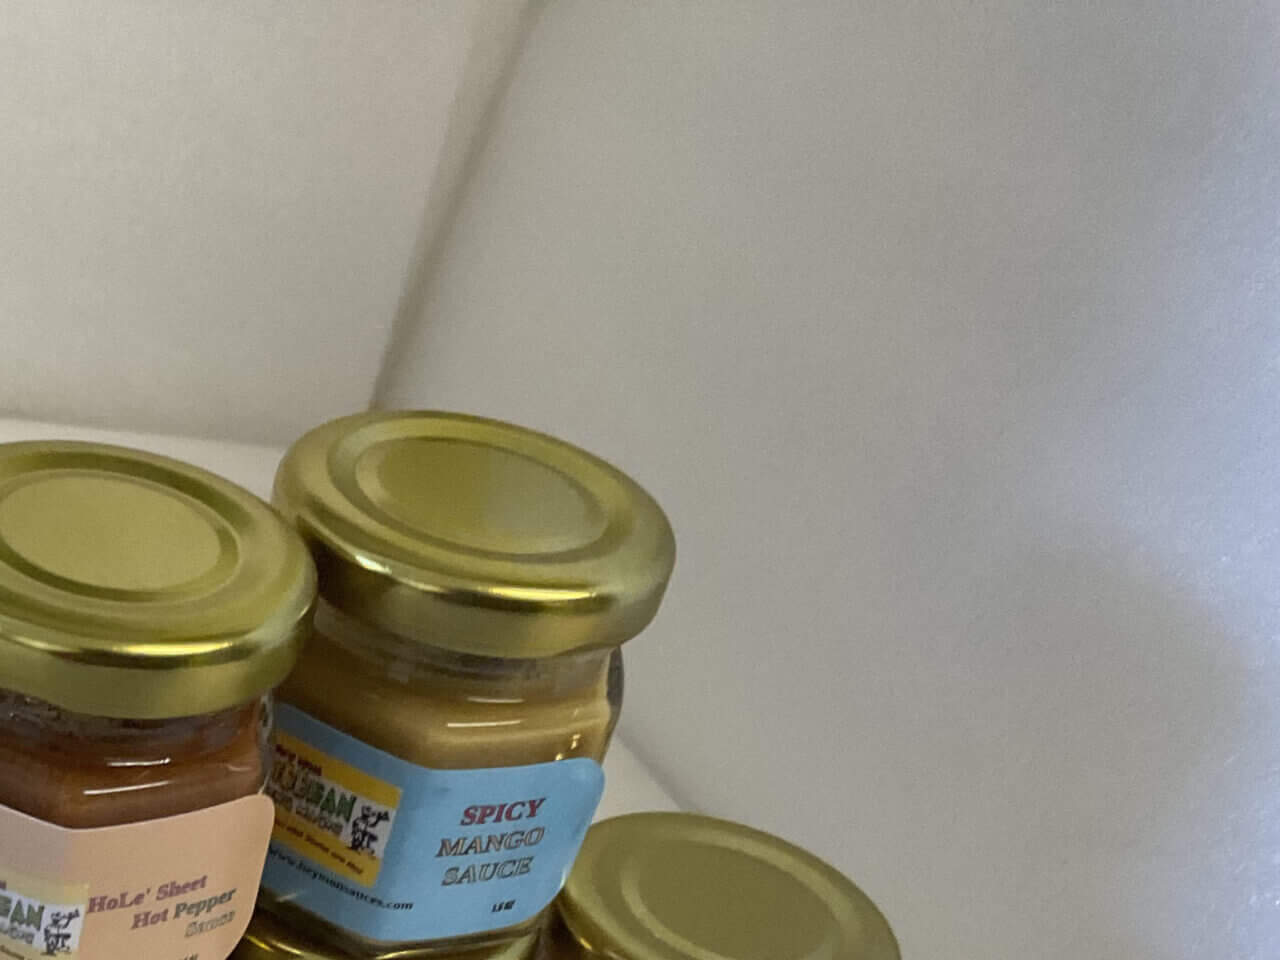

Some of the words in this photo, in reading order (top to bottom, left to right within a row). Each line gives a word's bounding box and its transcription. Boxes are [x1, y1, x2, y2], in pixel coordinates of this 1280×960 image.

[459, 797, 548, 826] SPICY
[434, 826, 545, 858] MANGO
[441, 855, 535, 887] SAUCE
[131, 907, 169, 930] Hot
[173, 887, 236, 920] Pepper
